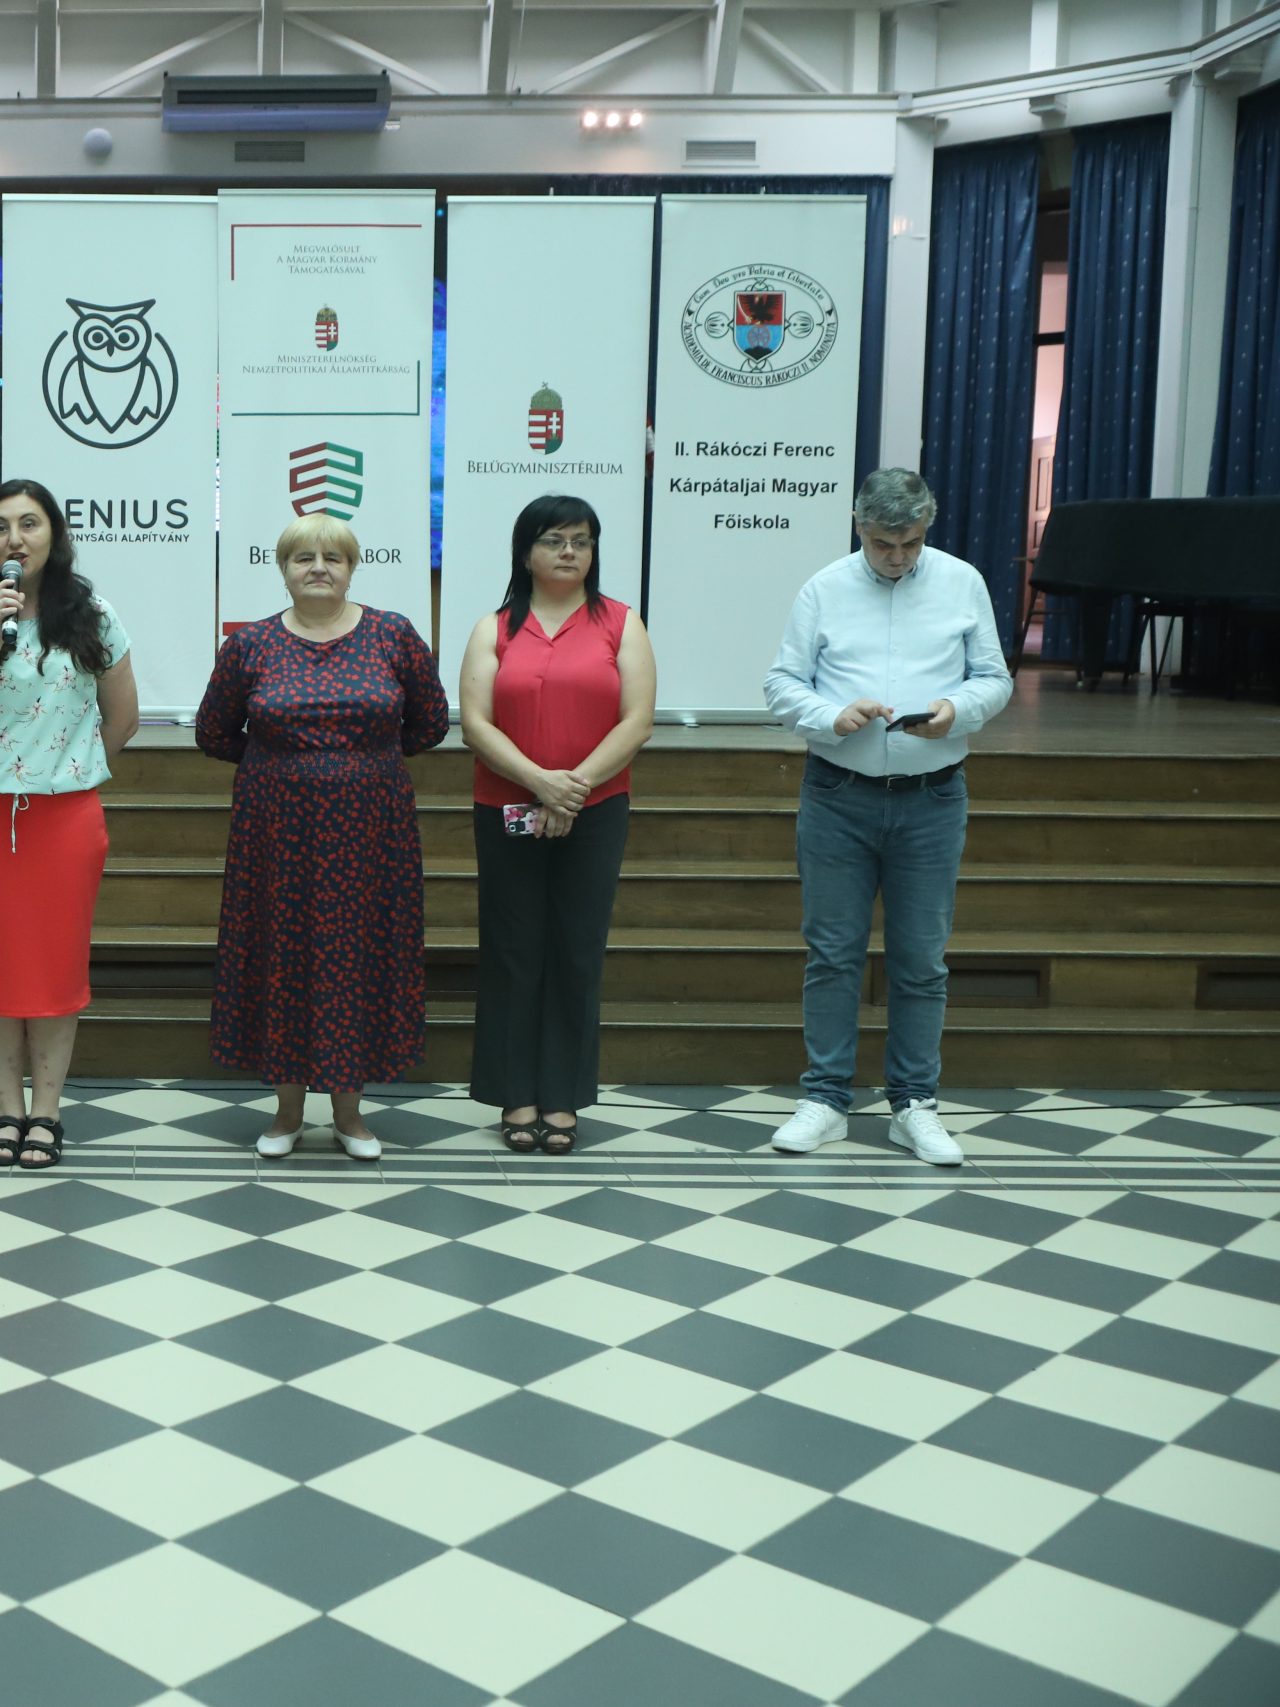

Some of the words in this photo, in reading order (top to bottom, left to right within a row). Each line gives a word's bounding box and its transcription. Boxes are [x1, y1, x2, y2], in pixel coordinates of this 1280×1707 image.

[675, 442, 690, 456] II.
[696, 441, 767, 457] Rákóczi
[773, 442, 835, 457] Ferenc
[670, 478, 766, 497] Kárpátaljai
[772, 478, 838, 497] Magyar
[65, 498, 189, 529] ENIUS
[714, 514, 790, 529] Főiskola
[121, 531, 190, 543] ALAPÍTVÁNY
